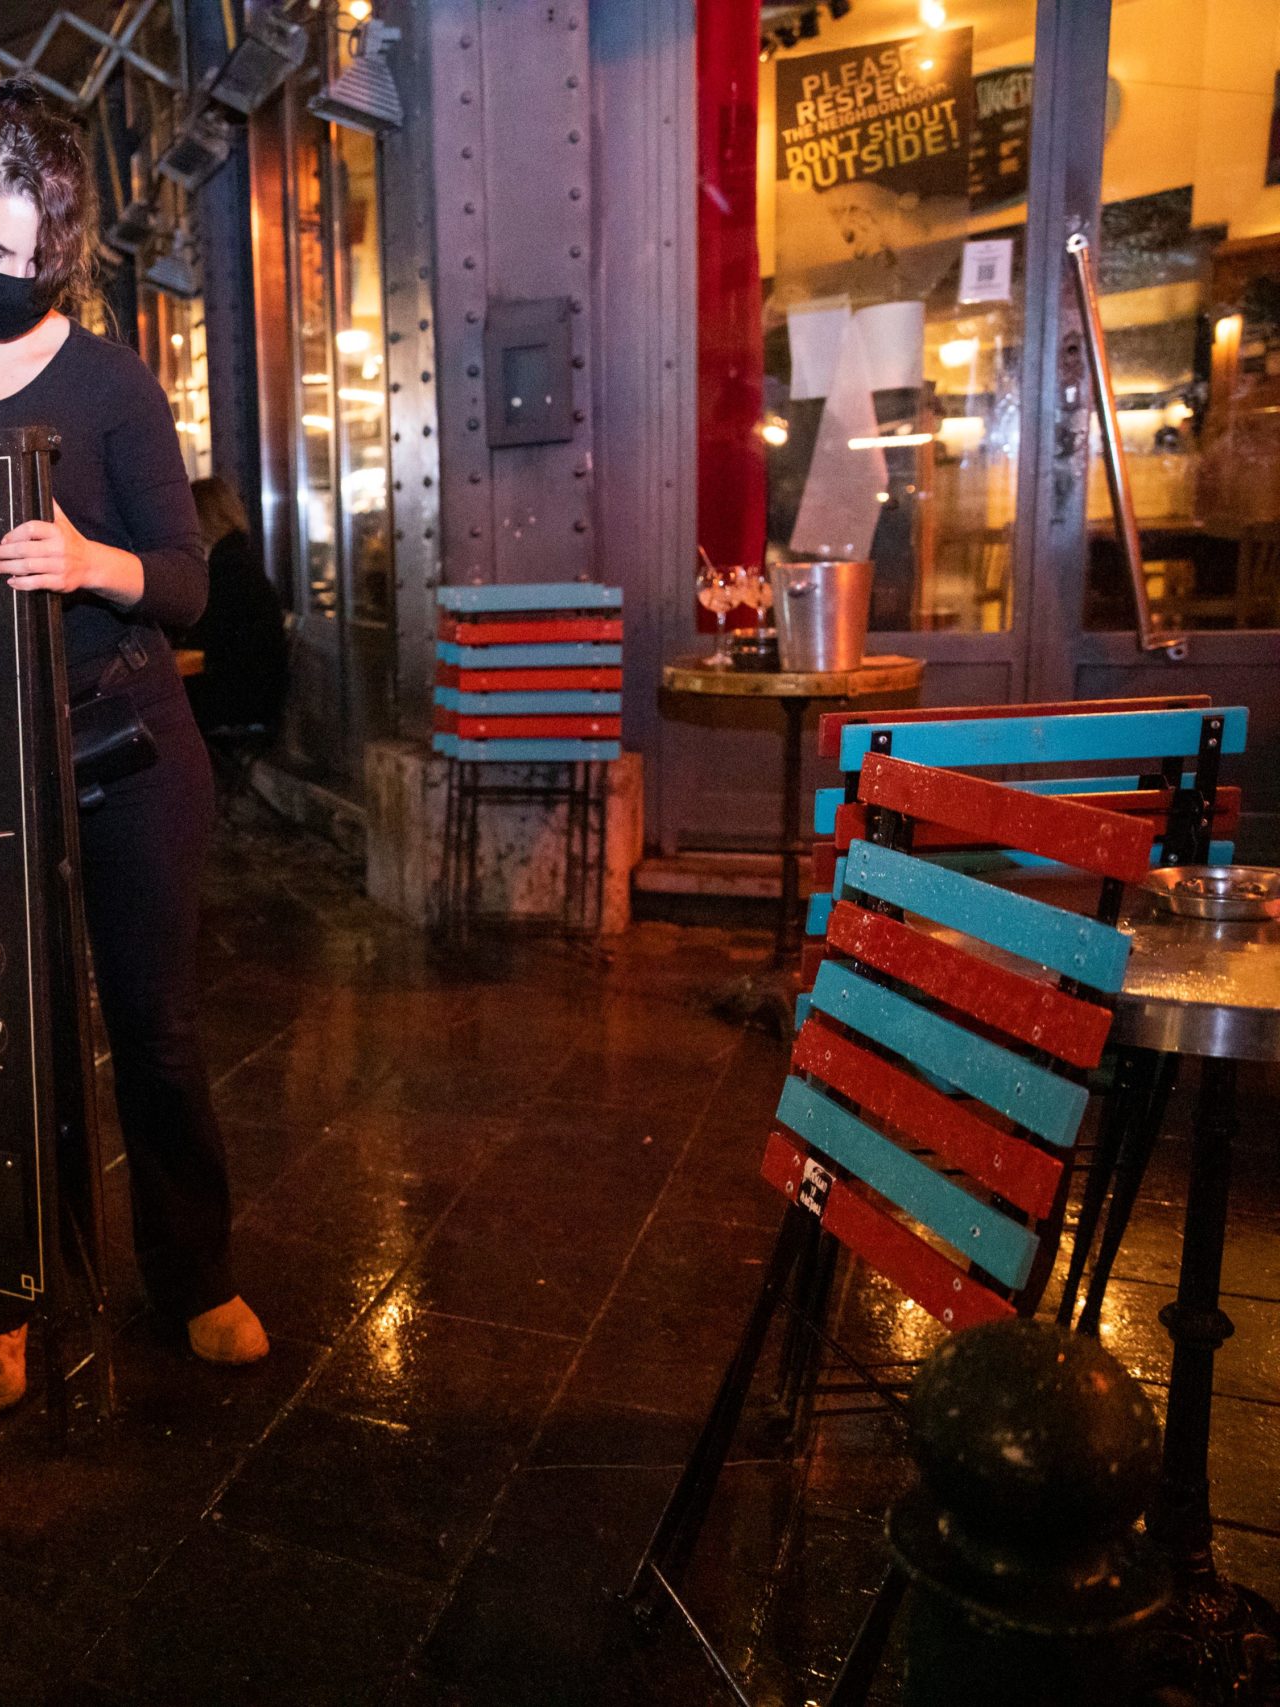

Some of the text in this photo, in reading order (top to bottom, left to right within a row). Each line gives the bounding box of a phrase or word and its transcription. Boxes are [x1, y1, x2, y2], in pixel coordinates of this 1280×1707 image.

[796, 66, 937, 125] RESPEC
[782, 124, 815, 144] THE
[786, 99, 956, 170] DON'T SHOUT
[788, 119, 961, 194] OUTSIDE!
